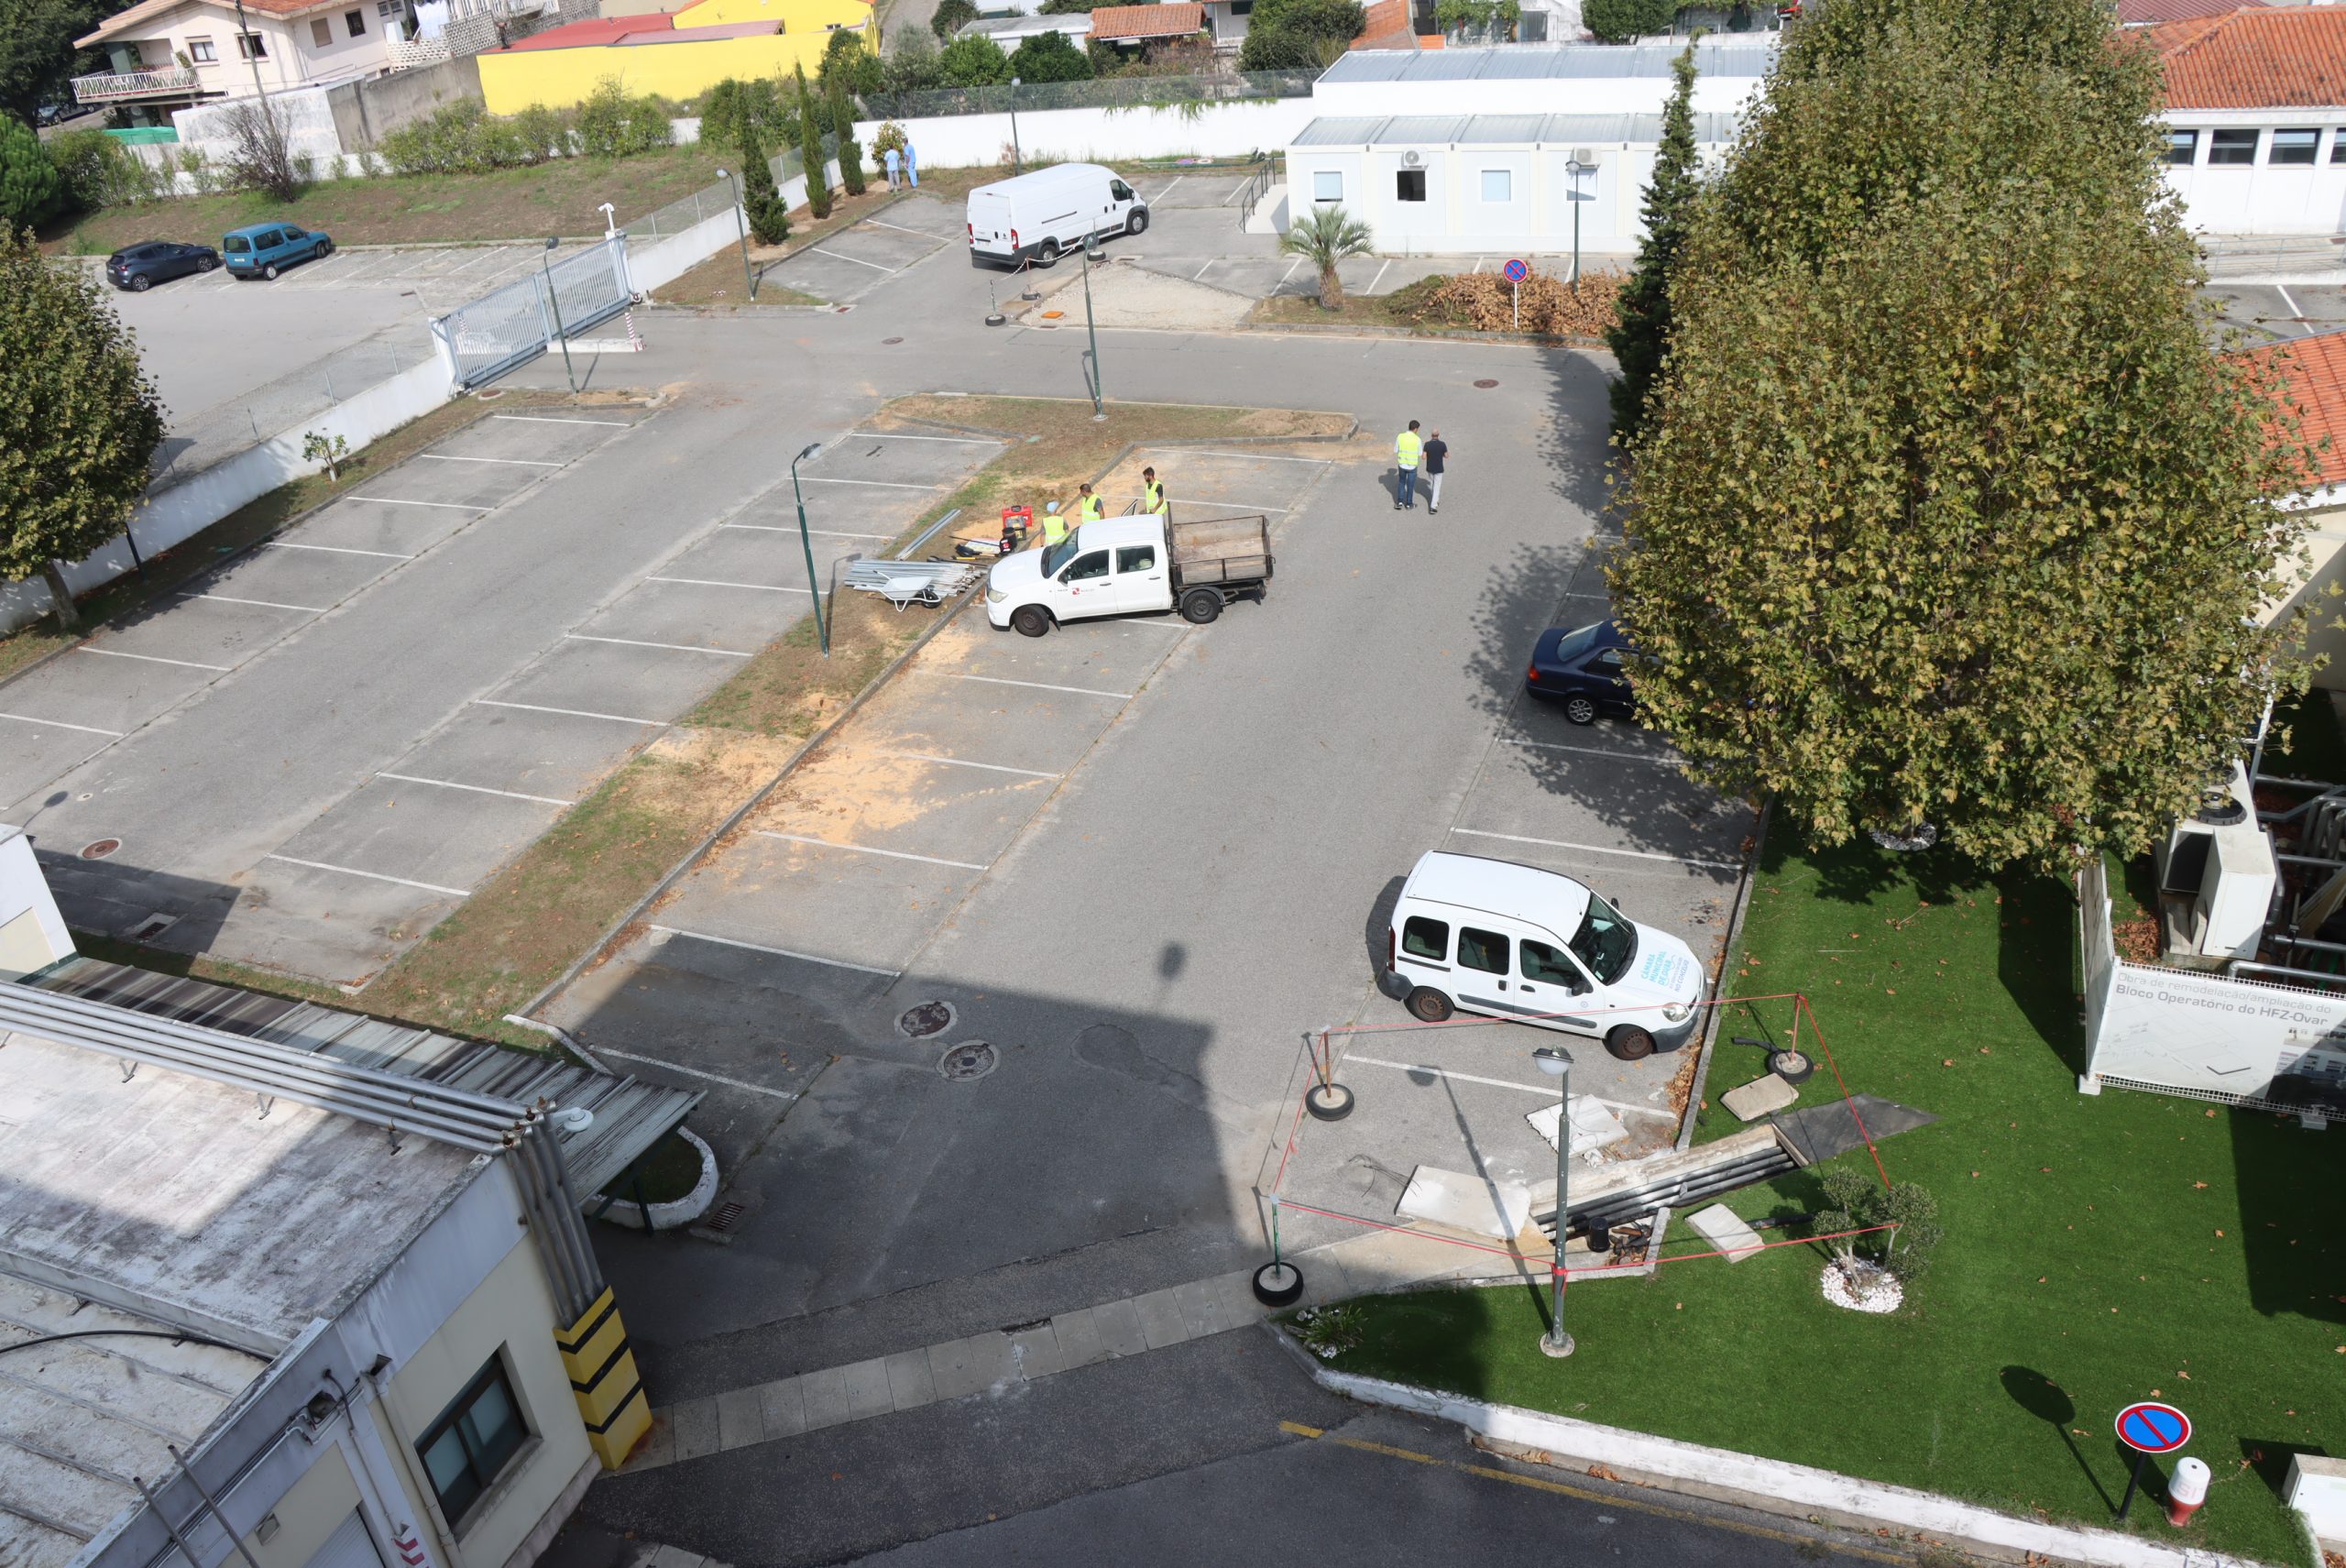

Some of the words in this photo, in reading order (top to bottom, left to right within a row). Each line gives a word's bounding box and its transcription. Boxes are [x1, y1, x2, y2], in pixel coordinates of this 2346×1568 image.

[1650, 951, 1666, 982] MUNICIPAL
[2116, 984, 2154, 999] Bloco
[2157, 991, 2234, 1011] Operatório
[2238, 1003, 2255, 1014] do
[2260, 1006, 2329, 1025] HFZ-Ovar
[2118, 972, 2146, 985] Obra
[2150, 978, 2164, 988] de
[2316, 1004, 2331, 1014] do
